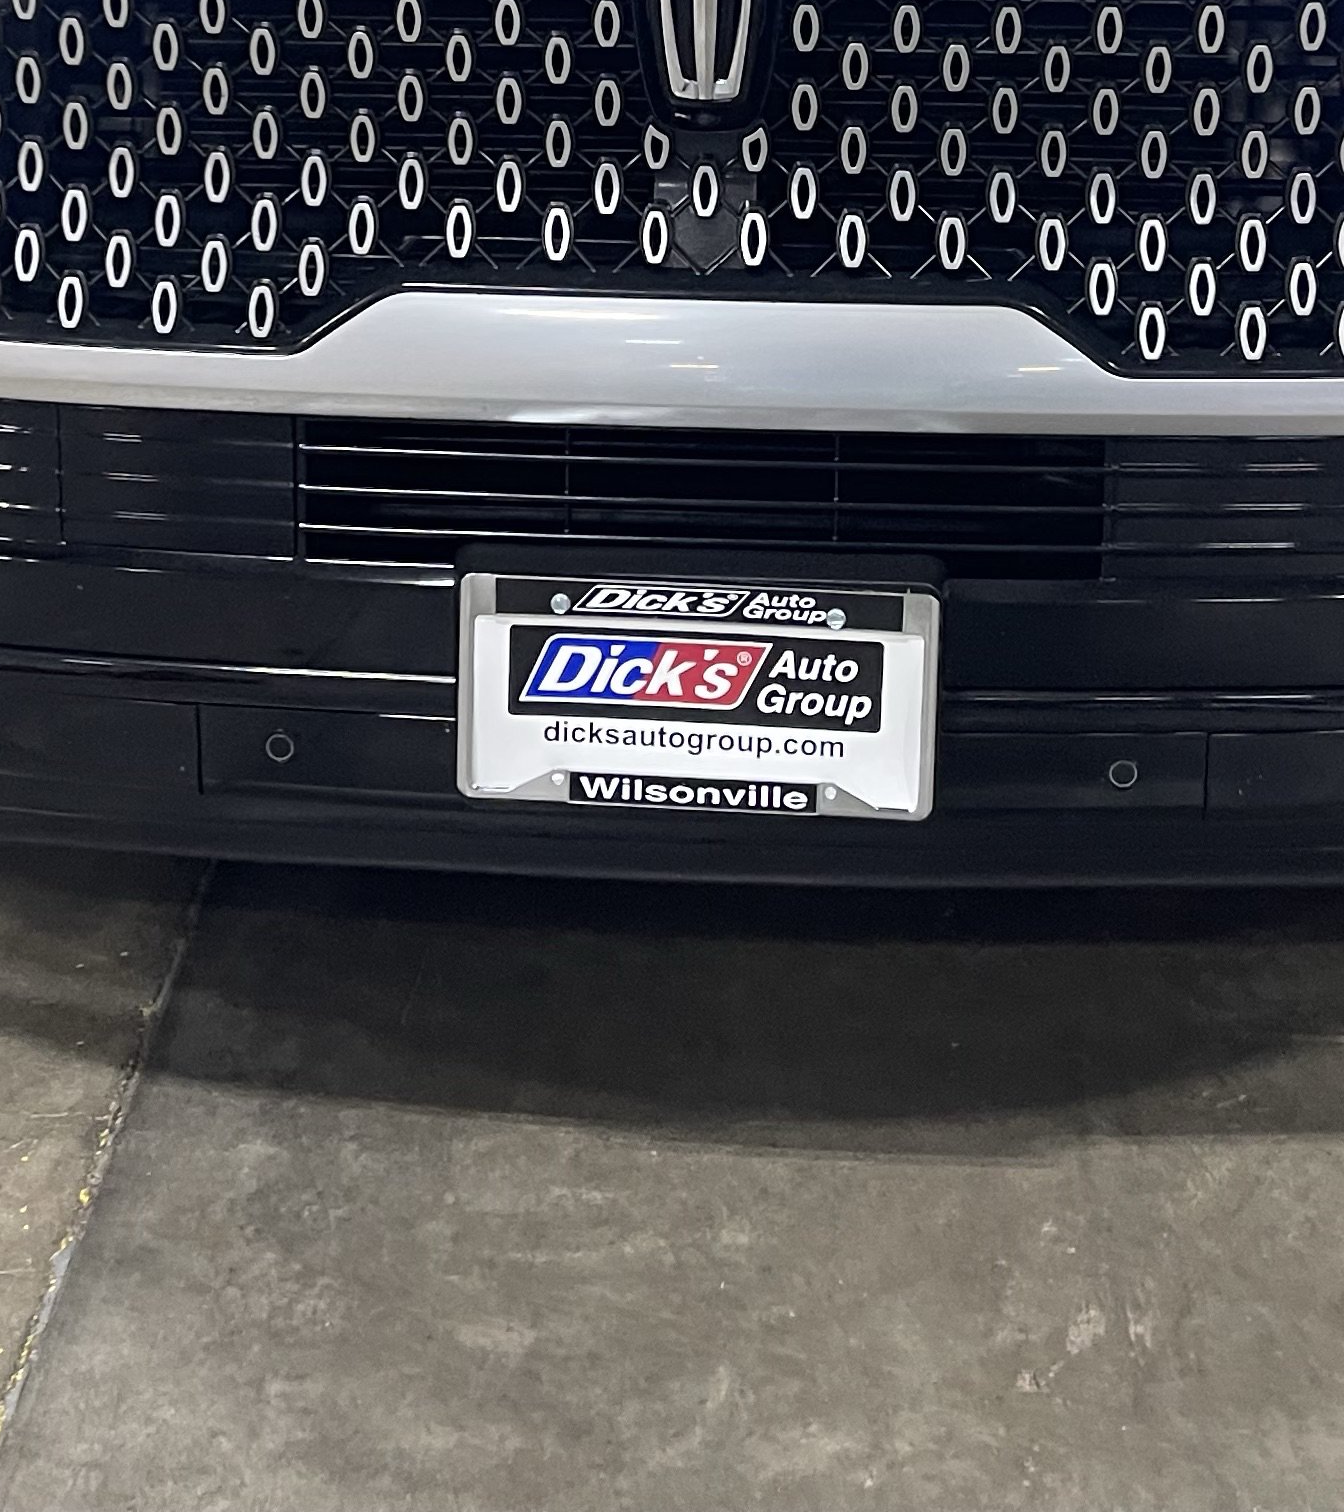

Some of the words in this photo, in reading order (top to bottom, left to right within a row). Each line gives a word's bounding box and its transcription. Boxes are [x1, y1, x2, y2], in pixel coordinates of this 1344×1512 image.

[585, 589, 732, 614] Dick's
[742, 605, 827, 625] Group
[749, 592, 816, 609] Auto
[537, 644, 739, 700] Dick's
[769, 650, 859, 683] Auto
[757, 684, 872, 726] Group
[543, 720, 845, 759] dicksautogroup.com
[578, 775, 808, 811] Wilsonville
